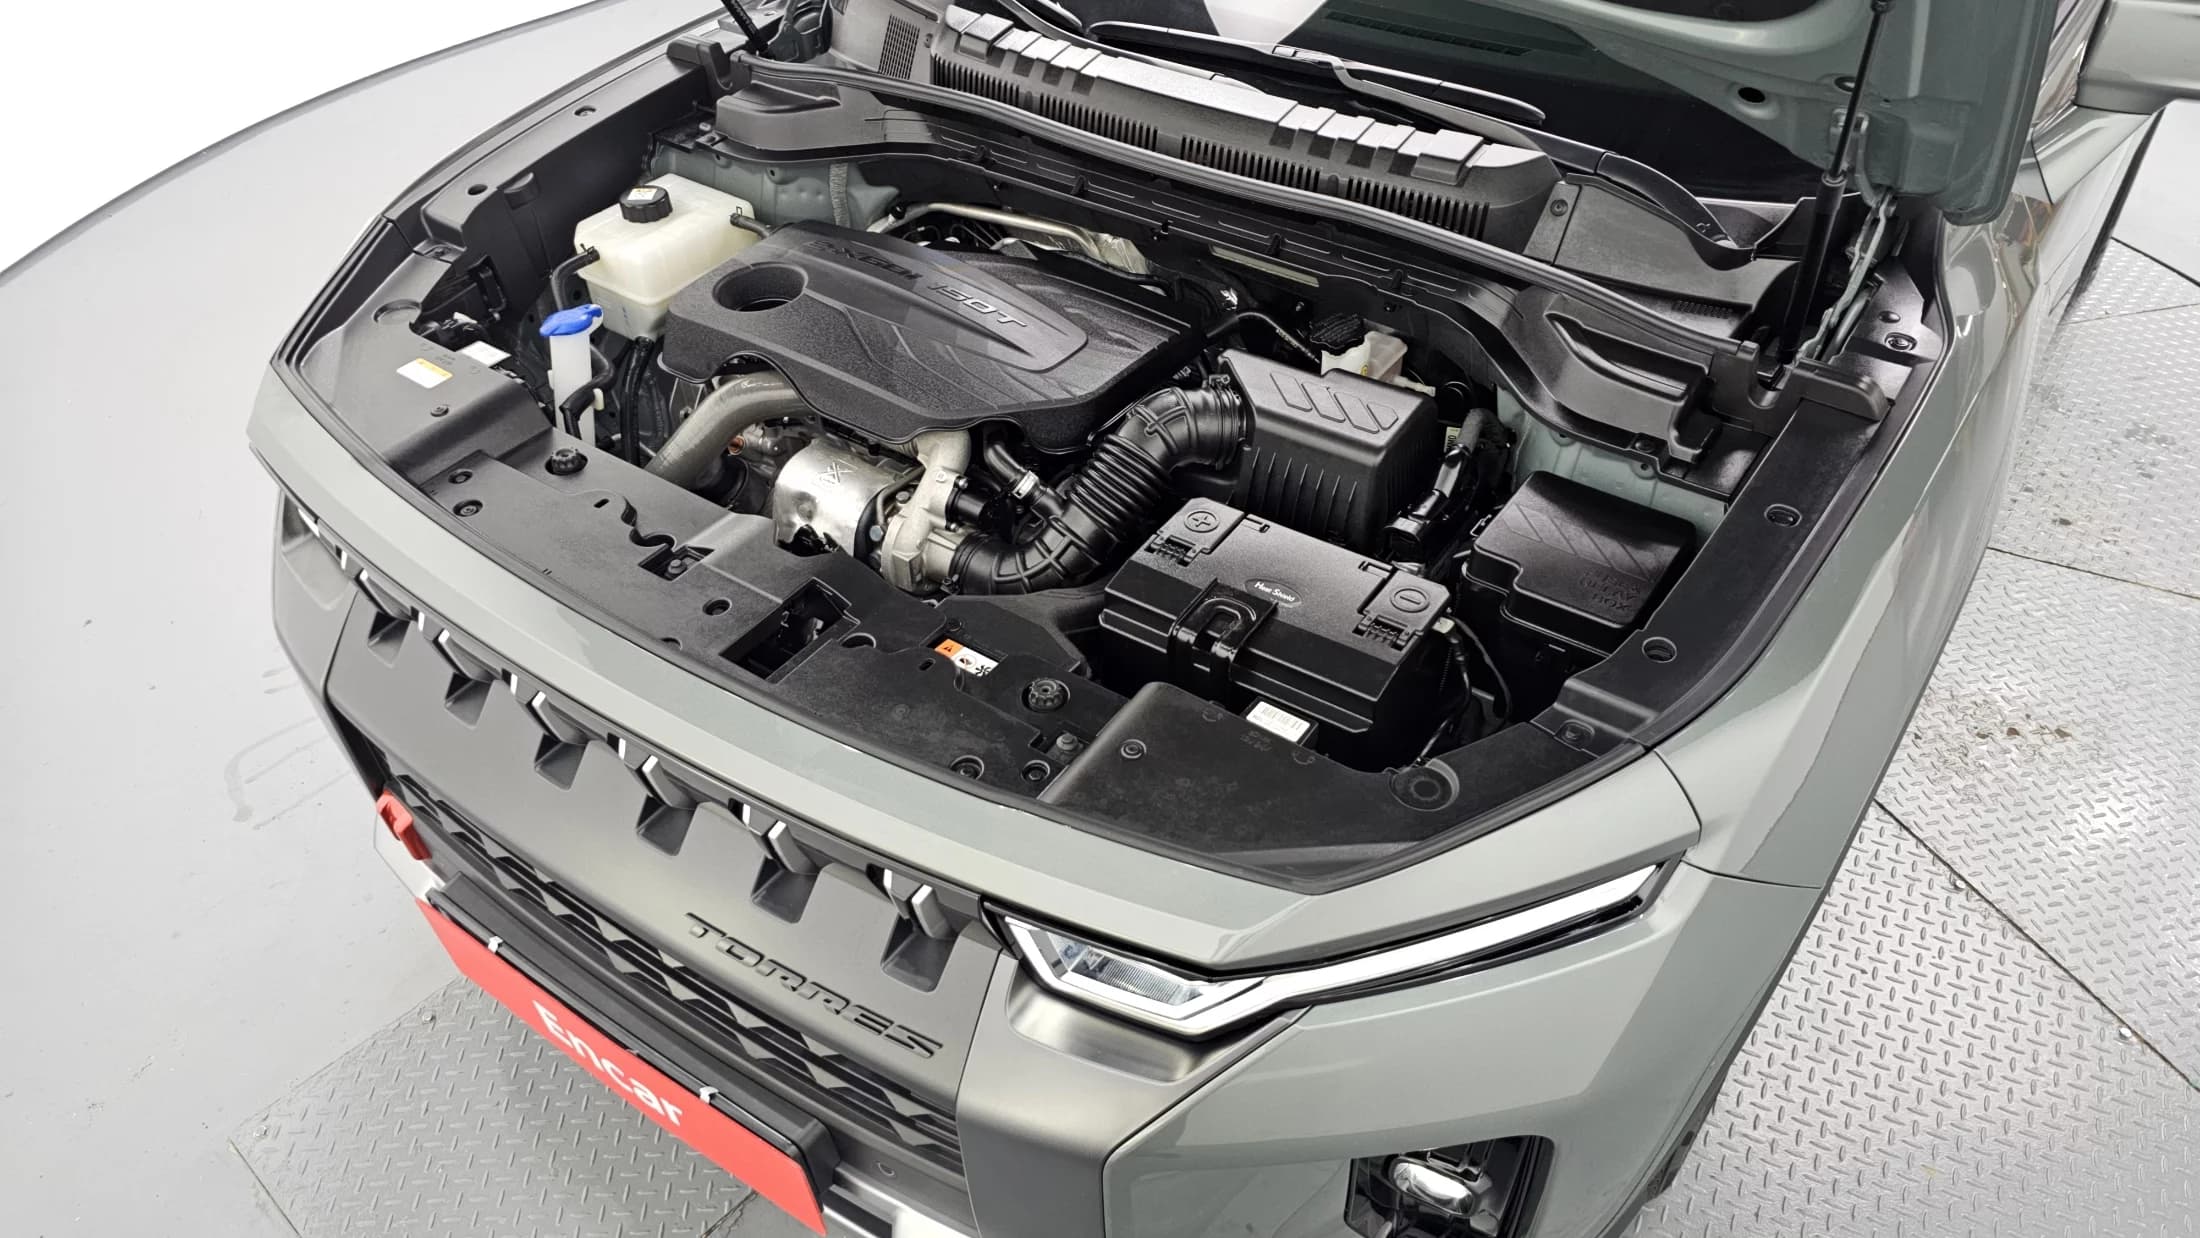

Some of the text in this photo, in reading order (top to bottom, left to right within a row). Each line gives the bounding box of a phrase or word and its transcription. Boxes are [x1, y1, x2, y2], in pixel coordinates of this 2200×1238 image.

[927, 284, 1028, 328] 150T
[685, 912, 944, 1059] TORRES
[532, 999, 683, 1127] Encar
